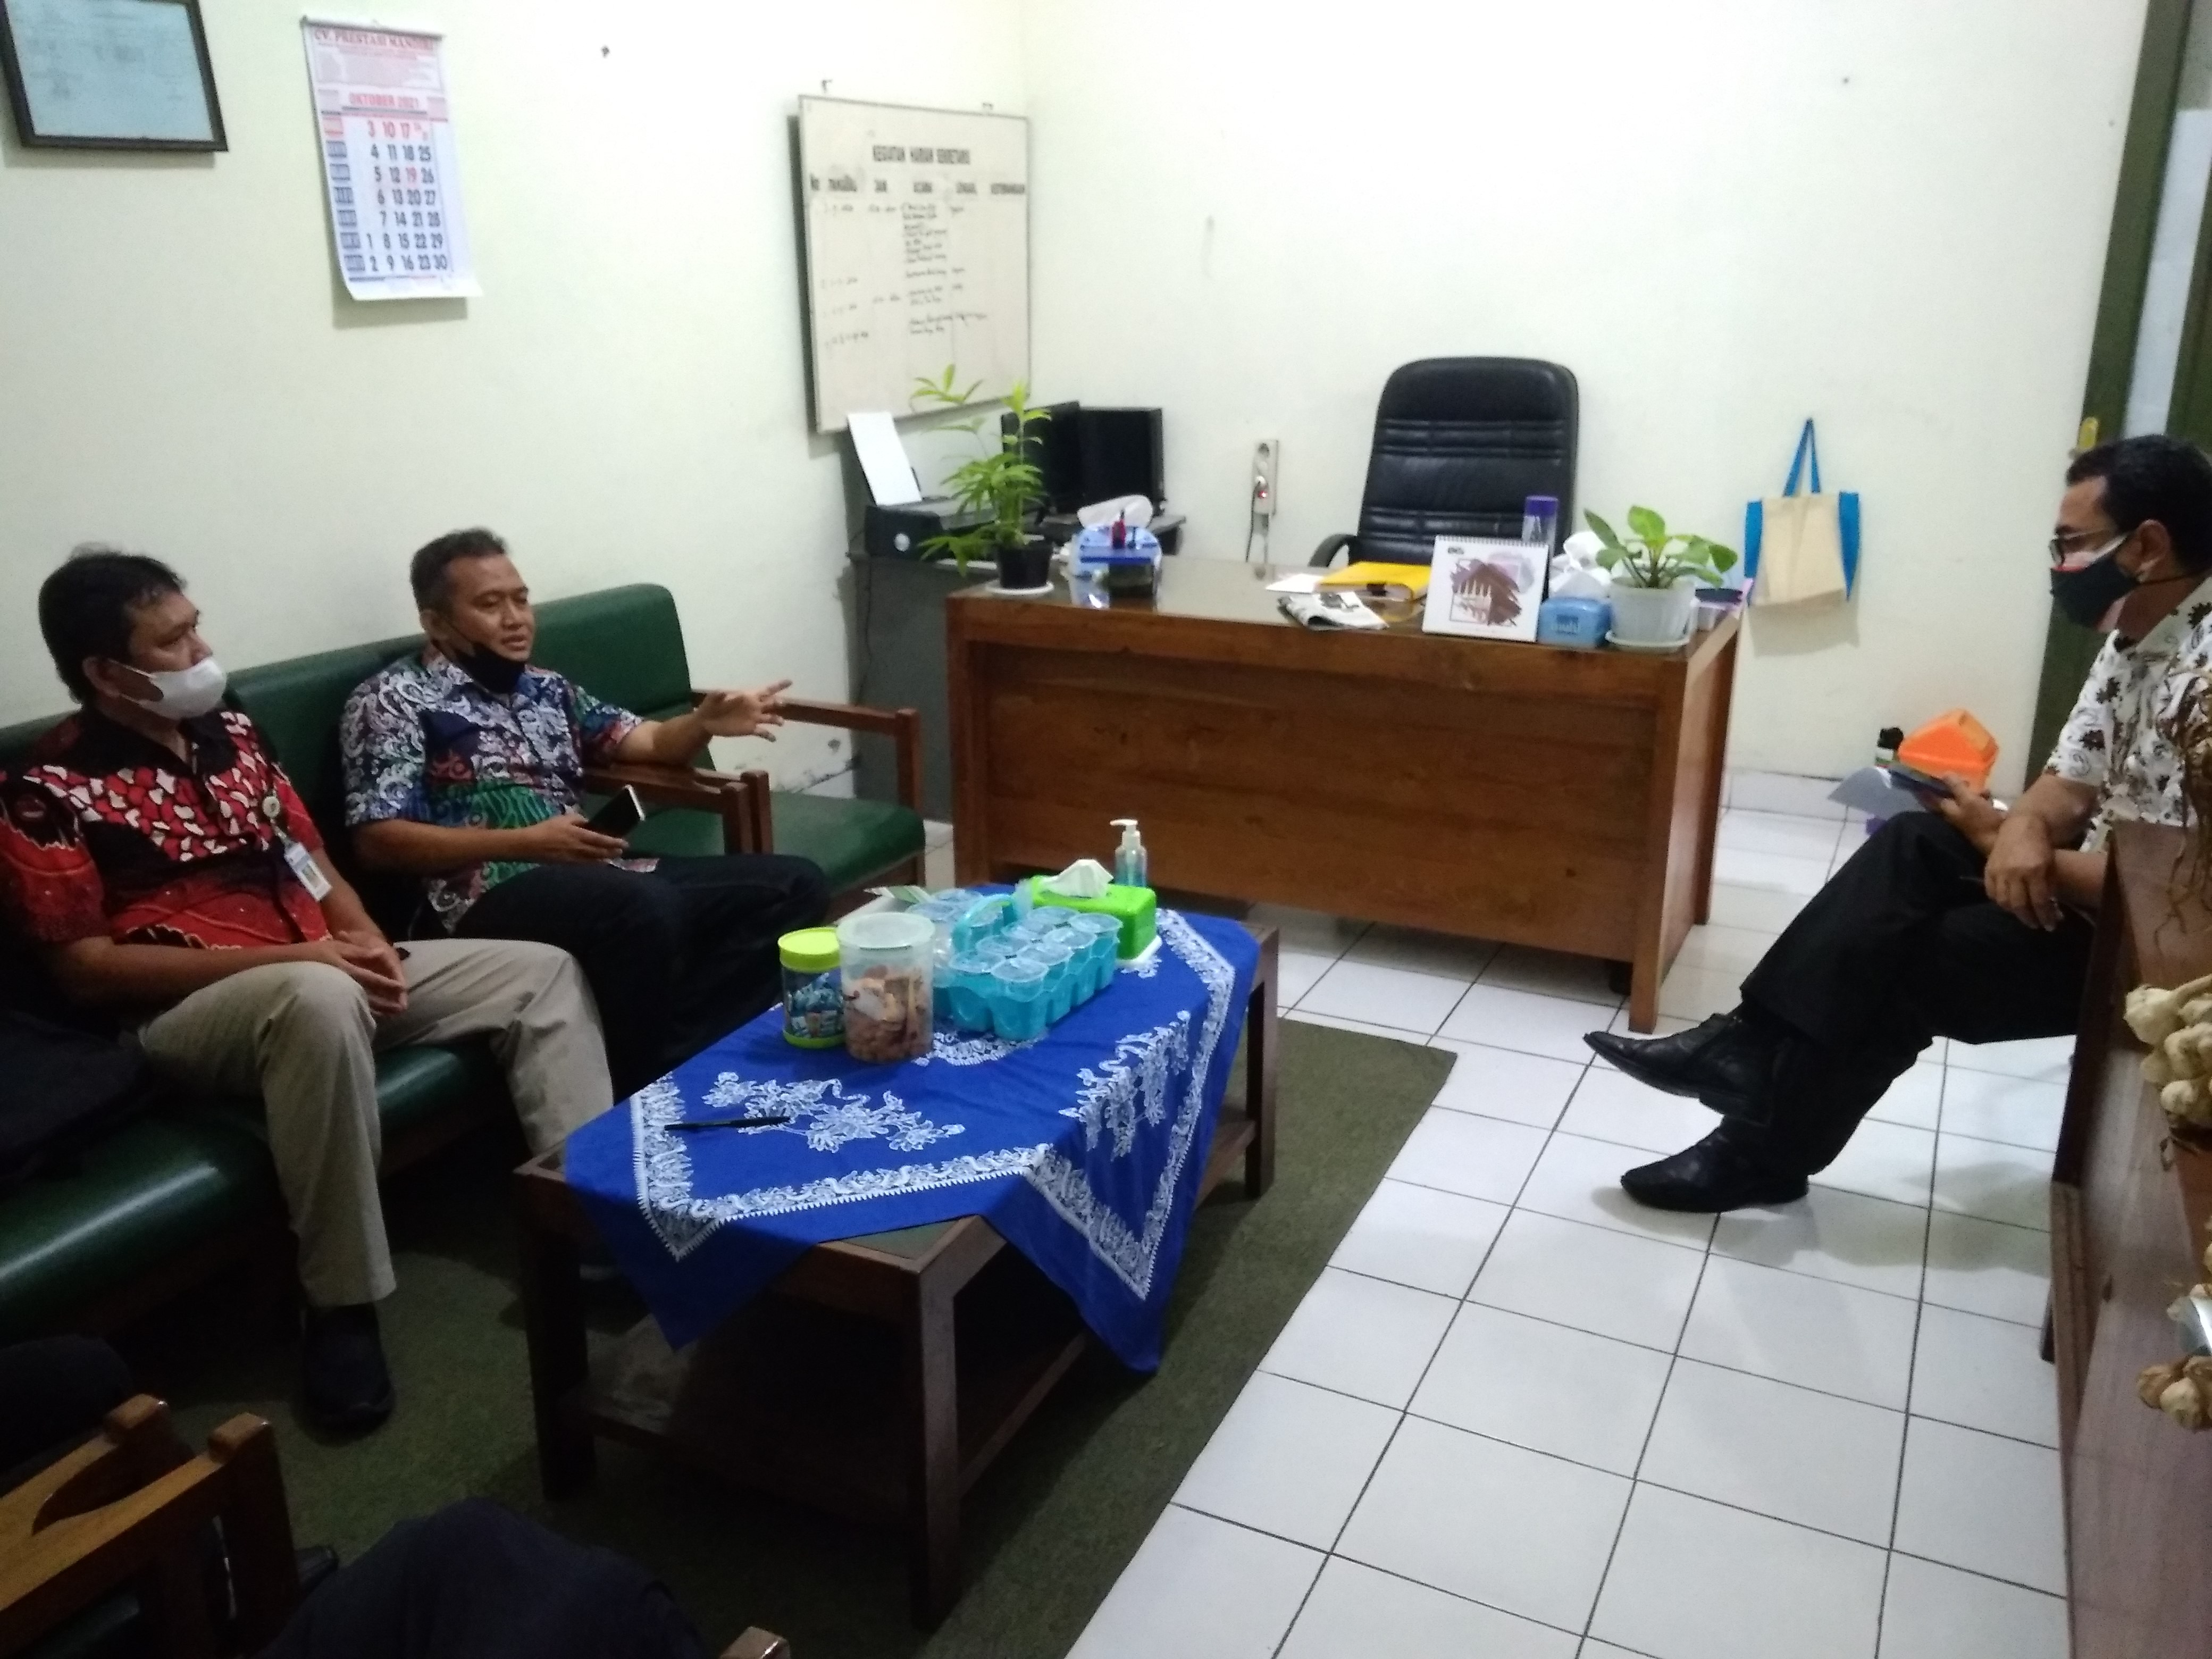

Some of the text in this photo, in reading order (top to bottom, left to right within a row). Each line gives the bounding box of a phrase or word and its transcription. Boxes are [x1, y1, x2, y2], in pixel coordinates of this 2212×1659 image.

[349, 93, 395, 107] OKTOBER
[367, 121, 375, 138] 3
[382, 121, 396, 138] 10
[400, 122, 410, 139] 17
[371, 144, 431, 162] 4 11 18 25
[374, 166, 434, 183] 5 12 19 26
[377, 188, 435, 206] 6 13 20 27
[379, 211, 441, 228] 7 14 21 28
[366, 233, 373, 249] 1
[383, 233, 391, 249] 8
[398, 233, 410, 249] 15
[414, 233, 427, 249] 22
[430, 233, 443, 249] 29
[370, 256, 379, 272] 2
[387, 255, 394, 271] 9
[401, 255, 414, 271] 16
[417, 255, 431, 271] 23
[433, 255, 448, 271] 30
